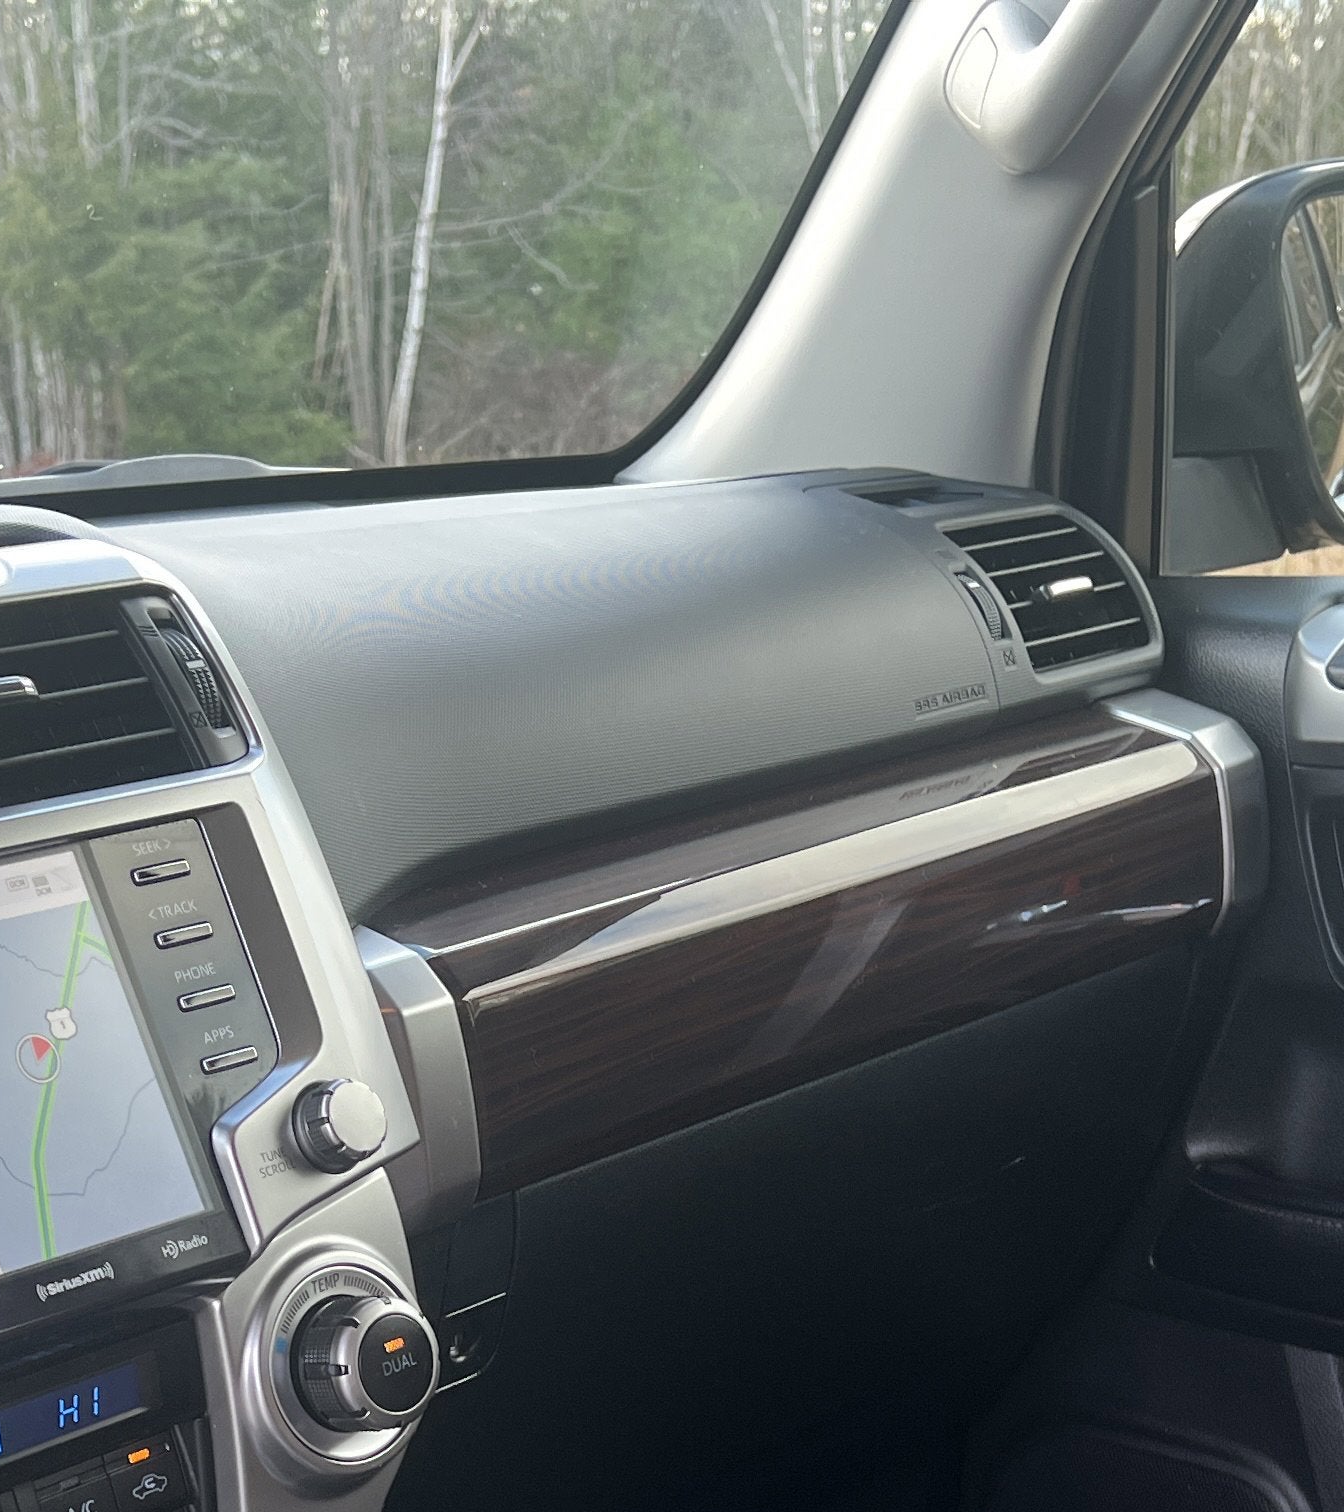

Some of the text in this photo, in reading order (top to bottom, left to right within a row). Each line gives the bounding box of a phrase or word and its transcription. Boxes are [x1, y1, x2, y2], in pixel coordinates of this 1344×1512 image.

[132, 839, 163, 856] SEEK
[157, 899, 197, 917] TRACK
[174, 963, 216, 984] PHONE
[203, 1026, 234, 1045] APPS
[177, 1234, 209, 1252] Radio
[311, 1274, 340, 1293] TEMP
[381, 1354, 418, 1376] DUAL
[58, 1387, 99, 1427] HI
